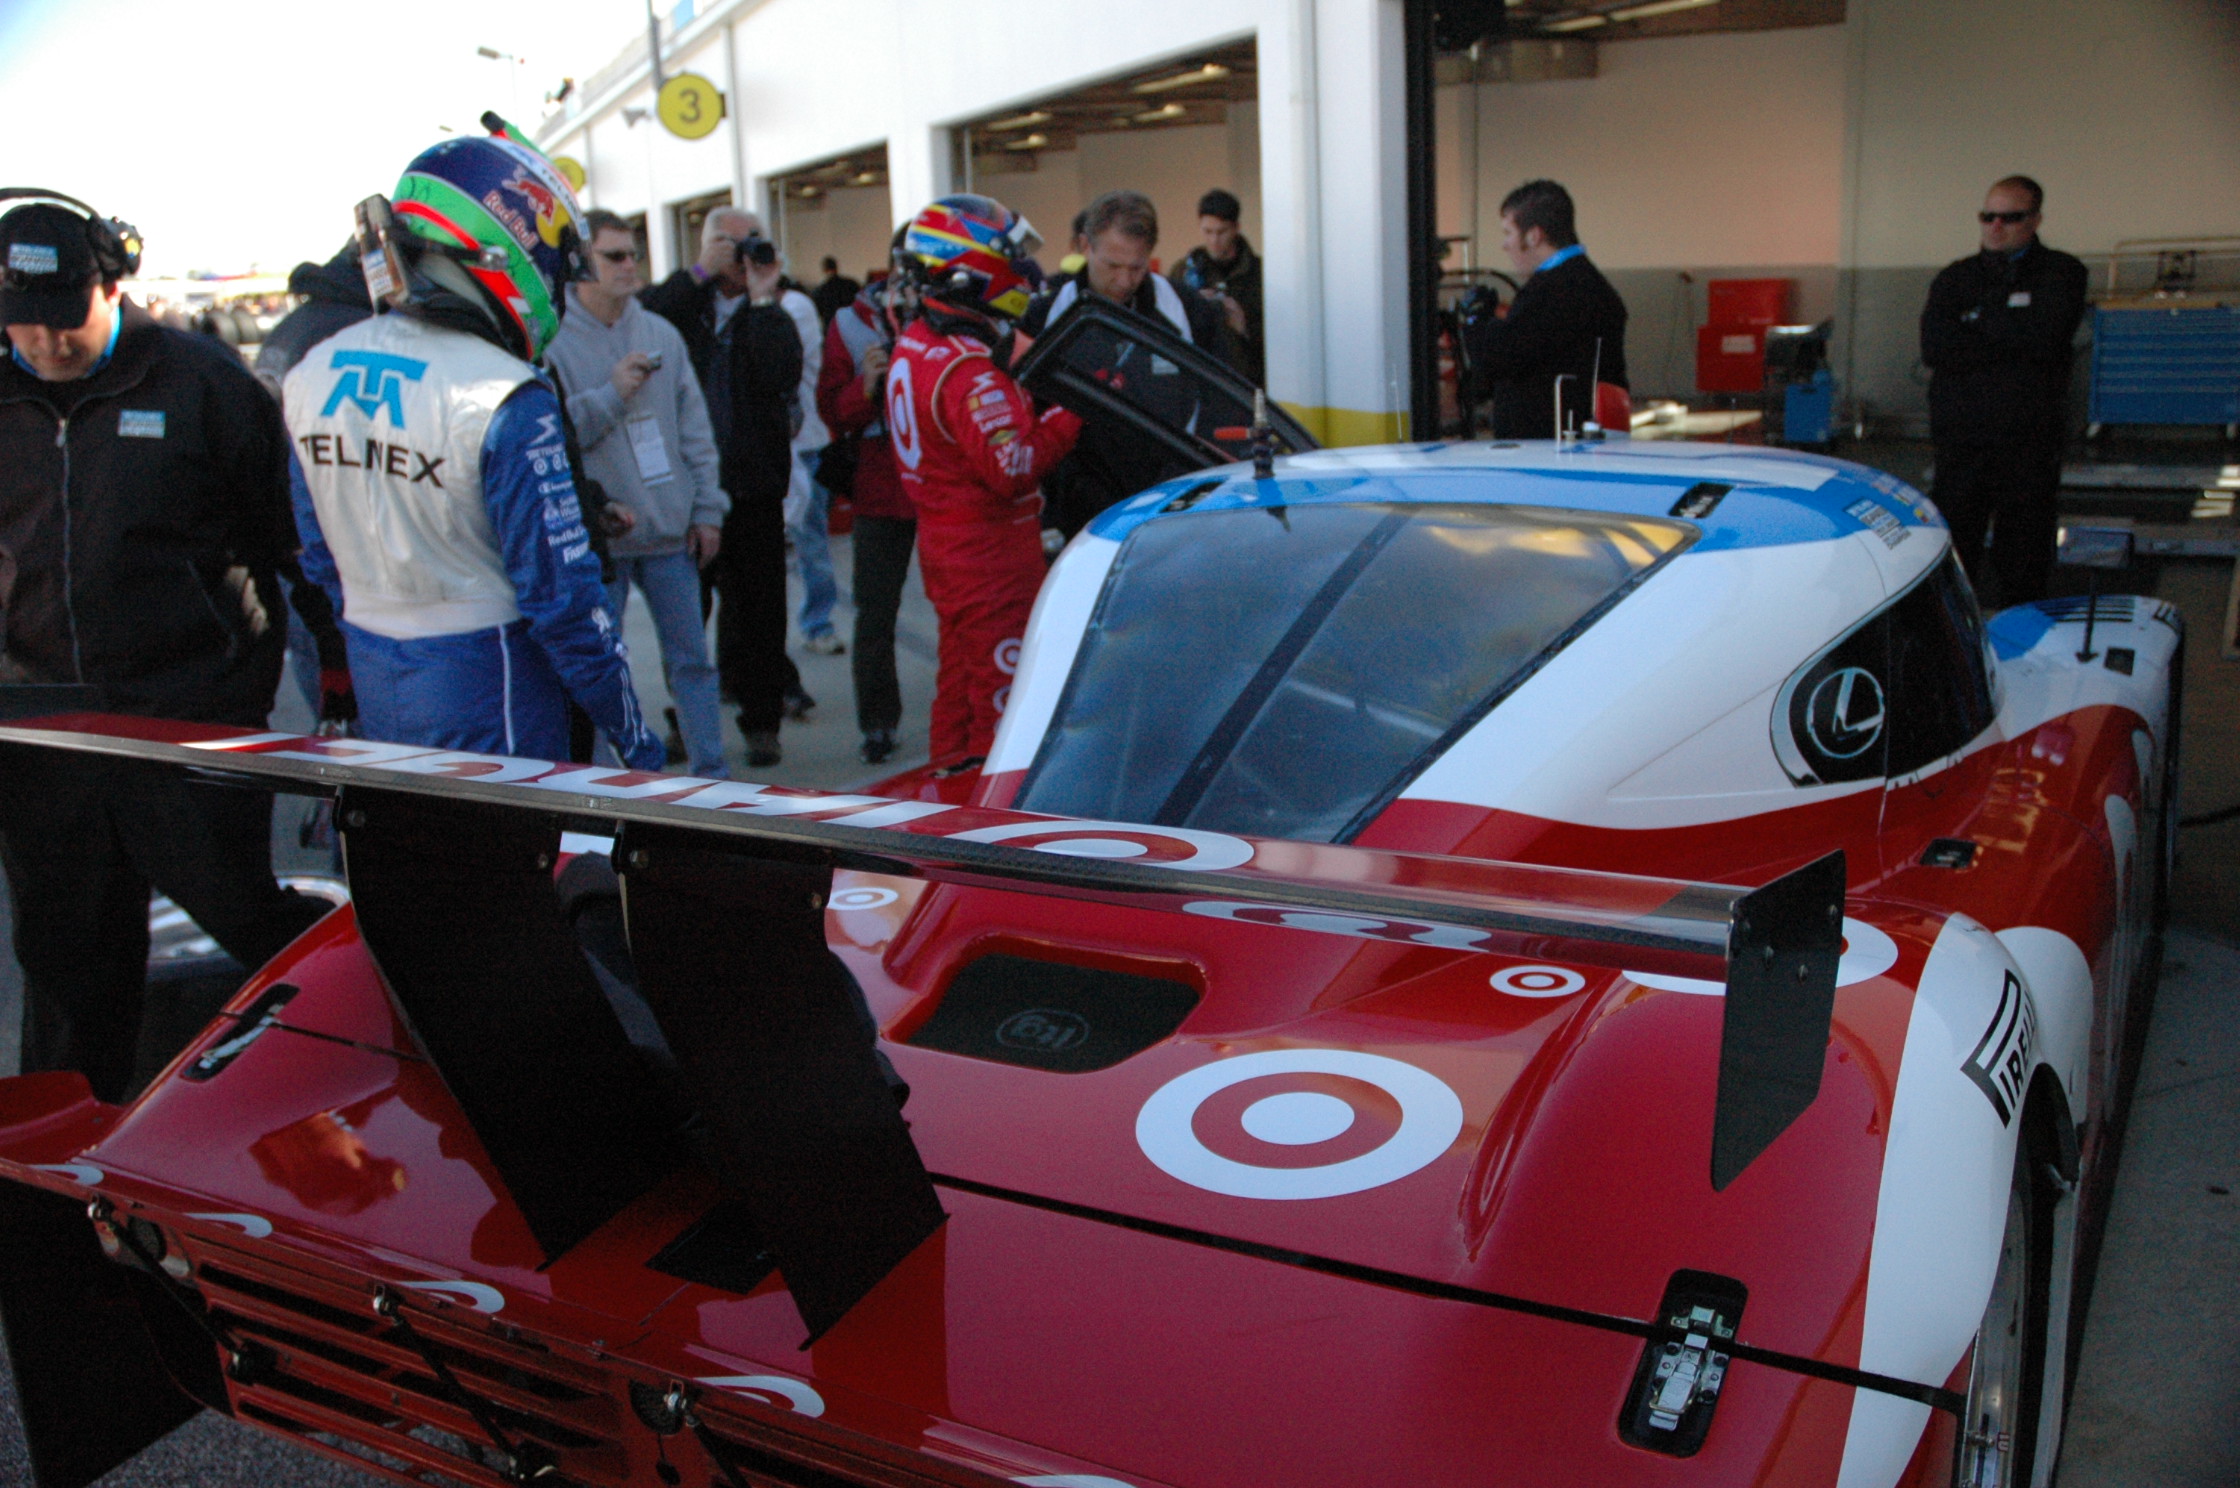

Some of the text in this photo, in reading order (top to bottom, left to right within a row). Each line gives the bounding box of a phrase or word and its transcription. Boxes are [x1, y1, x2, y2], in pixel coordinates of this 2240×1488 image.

[679, 88, 702, 125] 3
[483, 189, 539, 251] Red Bull
